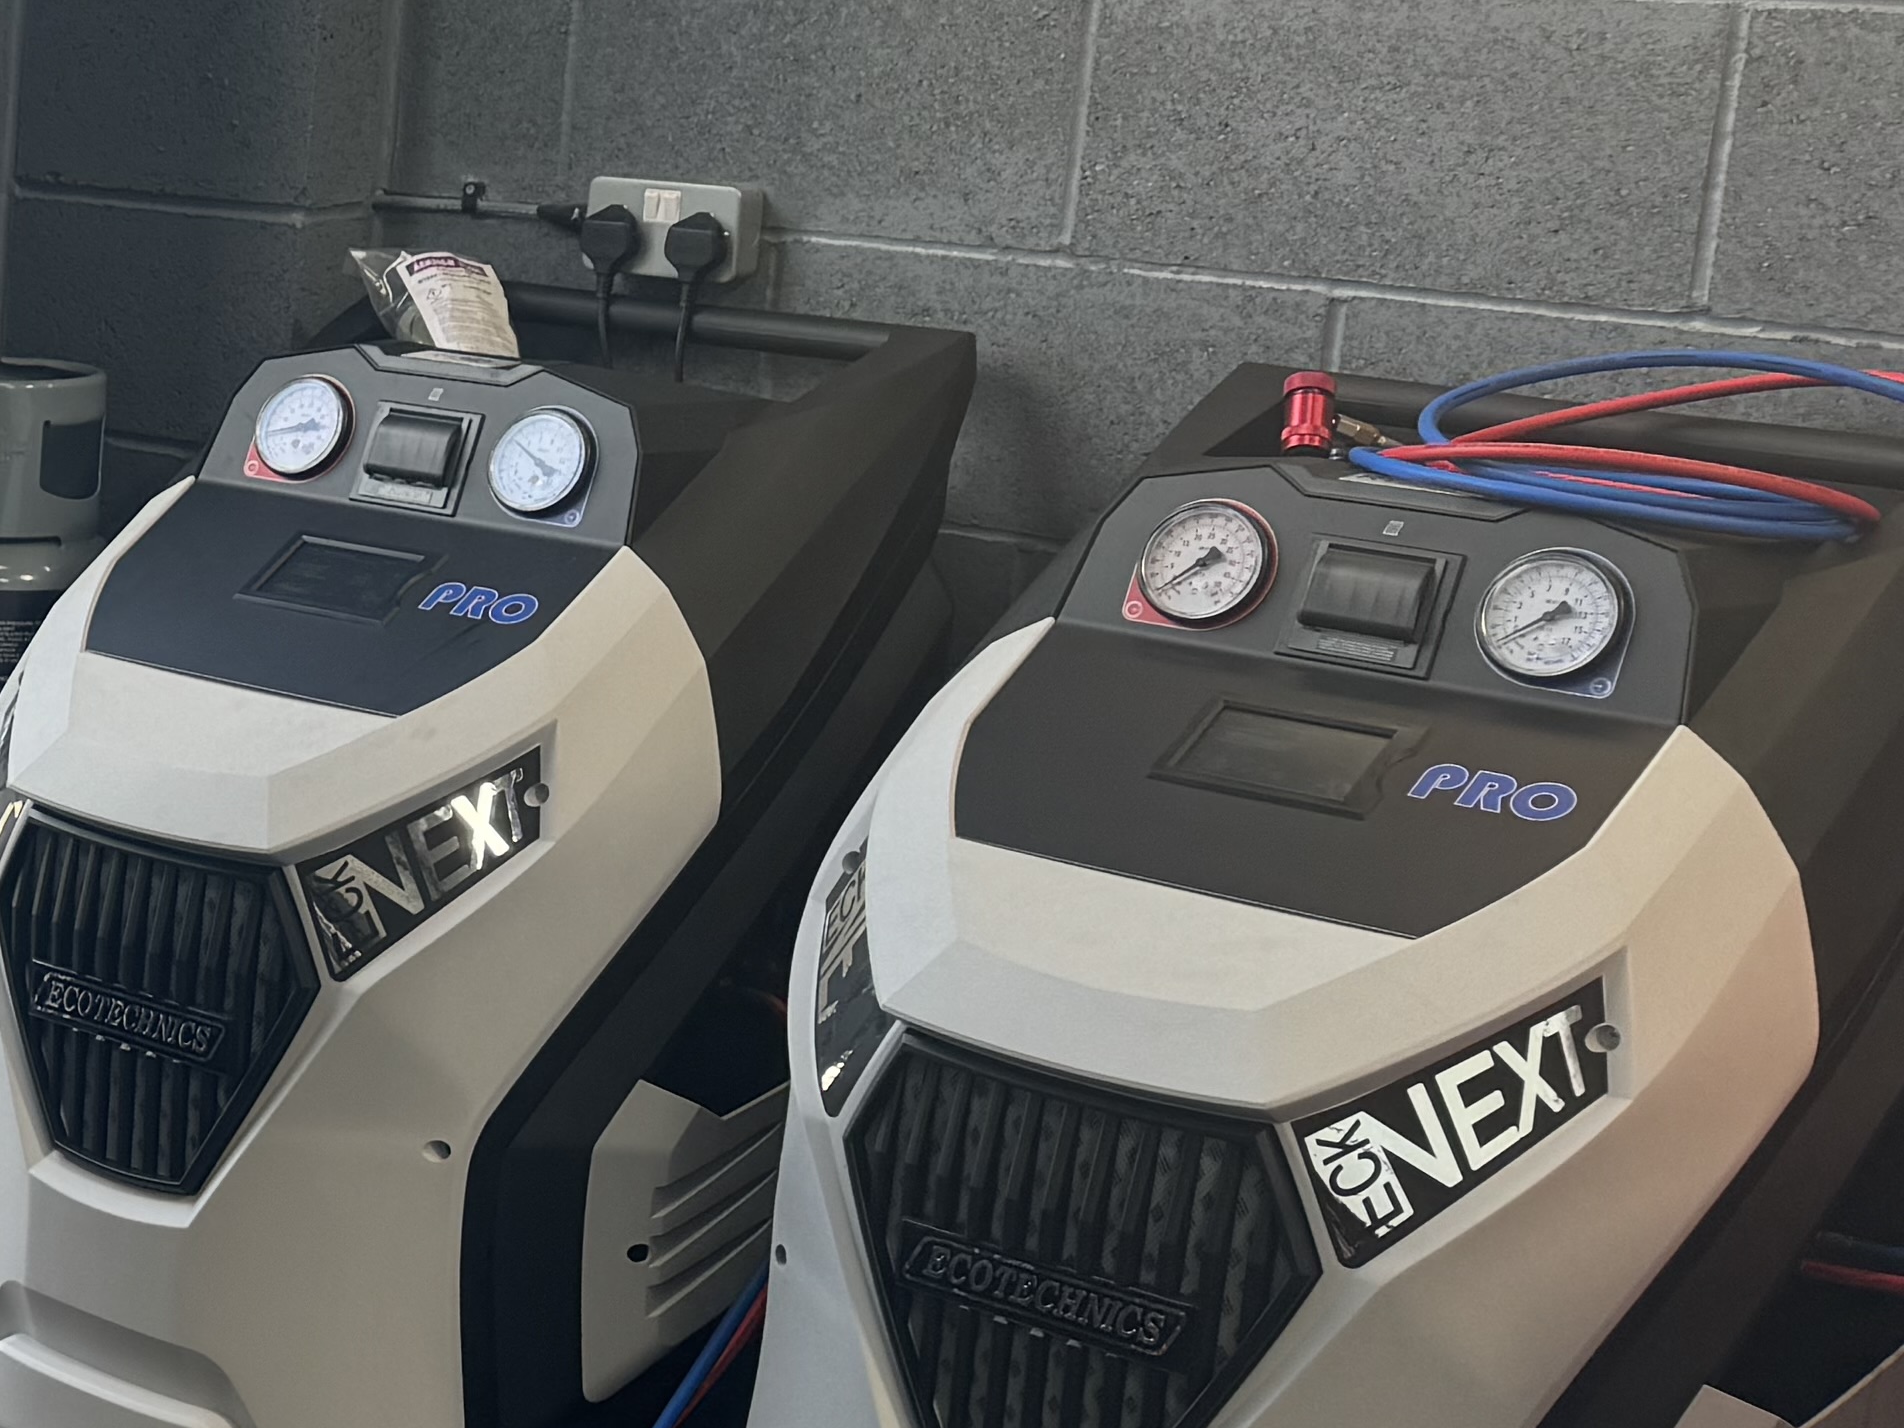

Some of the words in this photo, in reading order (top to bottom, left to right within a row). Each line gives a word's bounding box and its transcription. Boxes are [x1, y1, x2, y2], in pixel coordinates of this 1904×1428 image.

[419, 582, 539, 625] PRO
[1406, 763, 1579, 822] PRO
[316, 767, 524, 950] NEXT
[45, 979, 212, 1053] ECOTECHNICS
[1305, 1005, 1585, 1239] NEXT
[921, 1244, 1167, 1346] ECOTECHNICS
